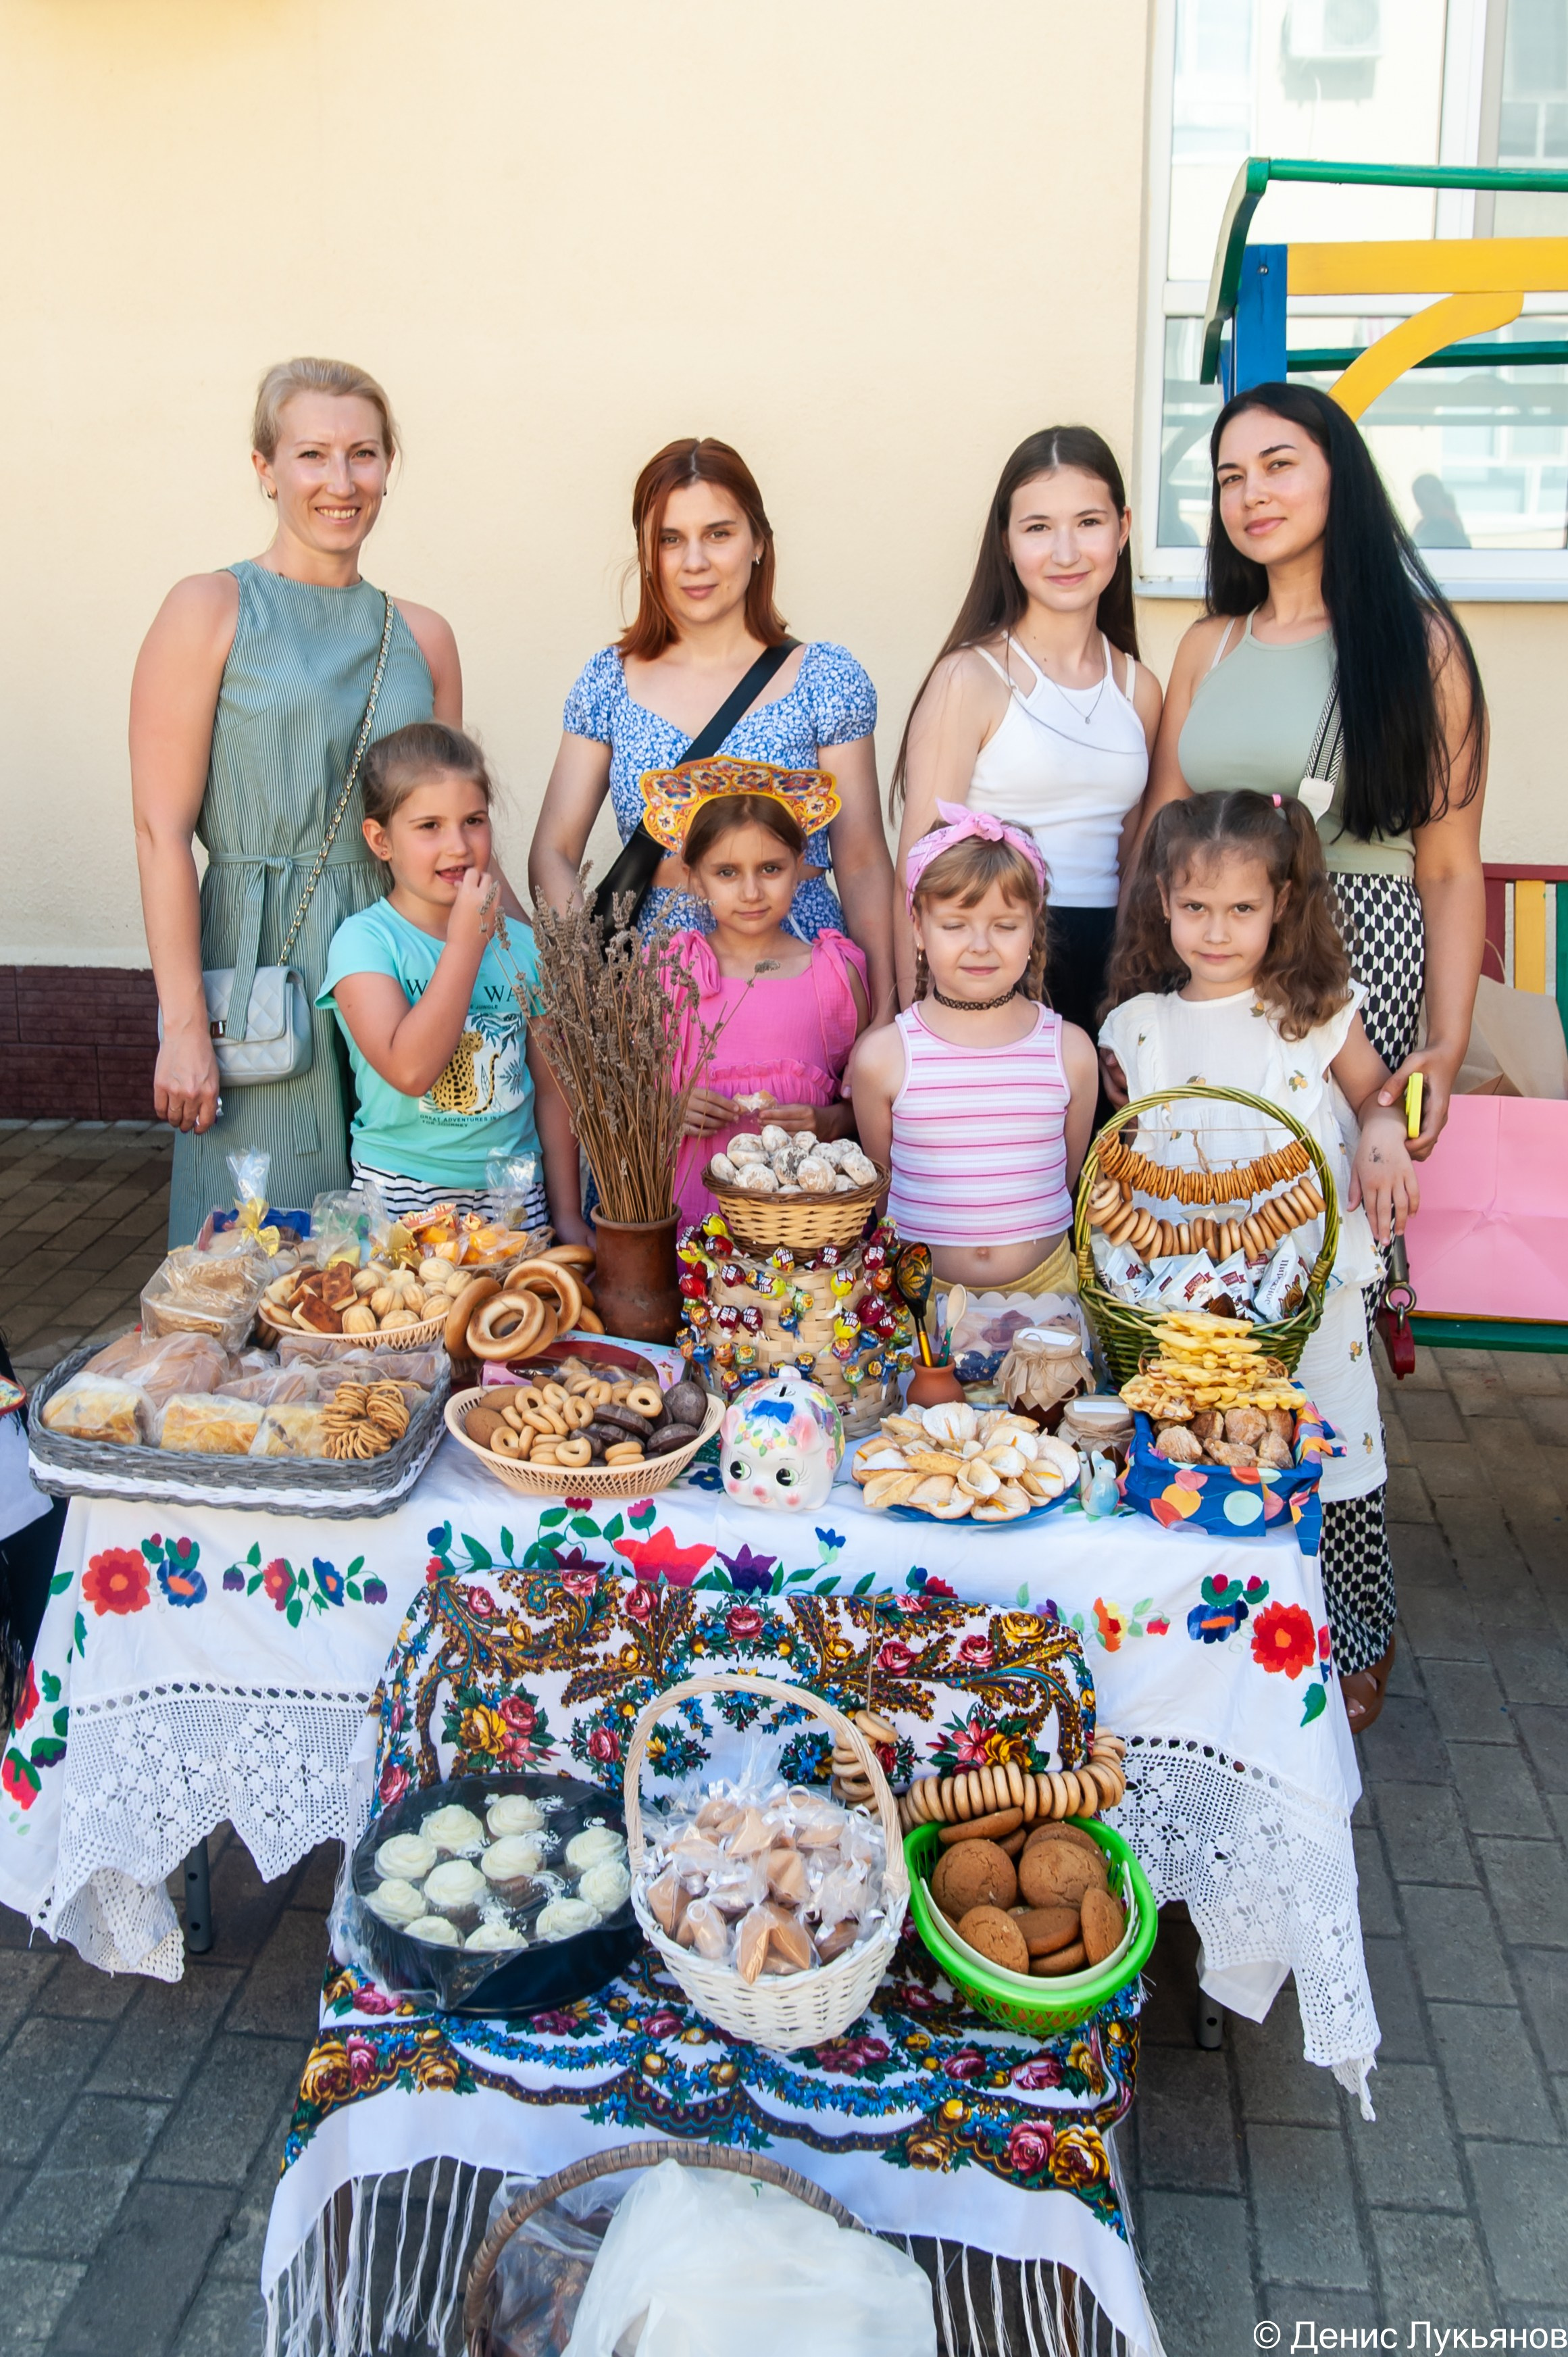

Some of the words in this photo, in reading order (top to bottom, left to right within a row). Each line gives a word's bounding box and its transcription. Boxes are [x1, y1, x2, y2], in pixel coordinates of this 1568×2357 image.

[420, 1114, 440, 1122] GREAT
[823, 1255, 838, 1264] MIX
[743, 1314, 757, 1324] MIX
[844, 1317, 859, 1327] MIX
